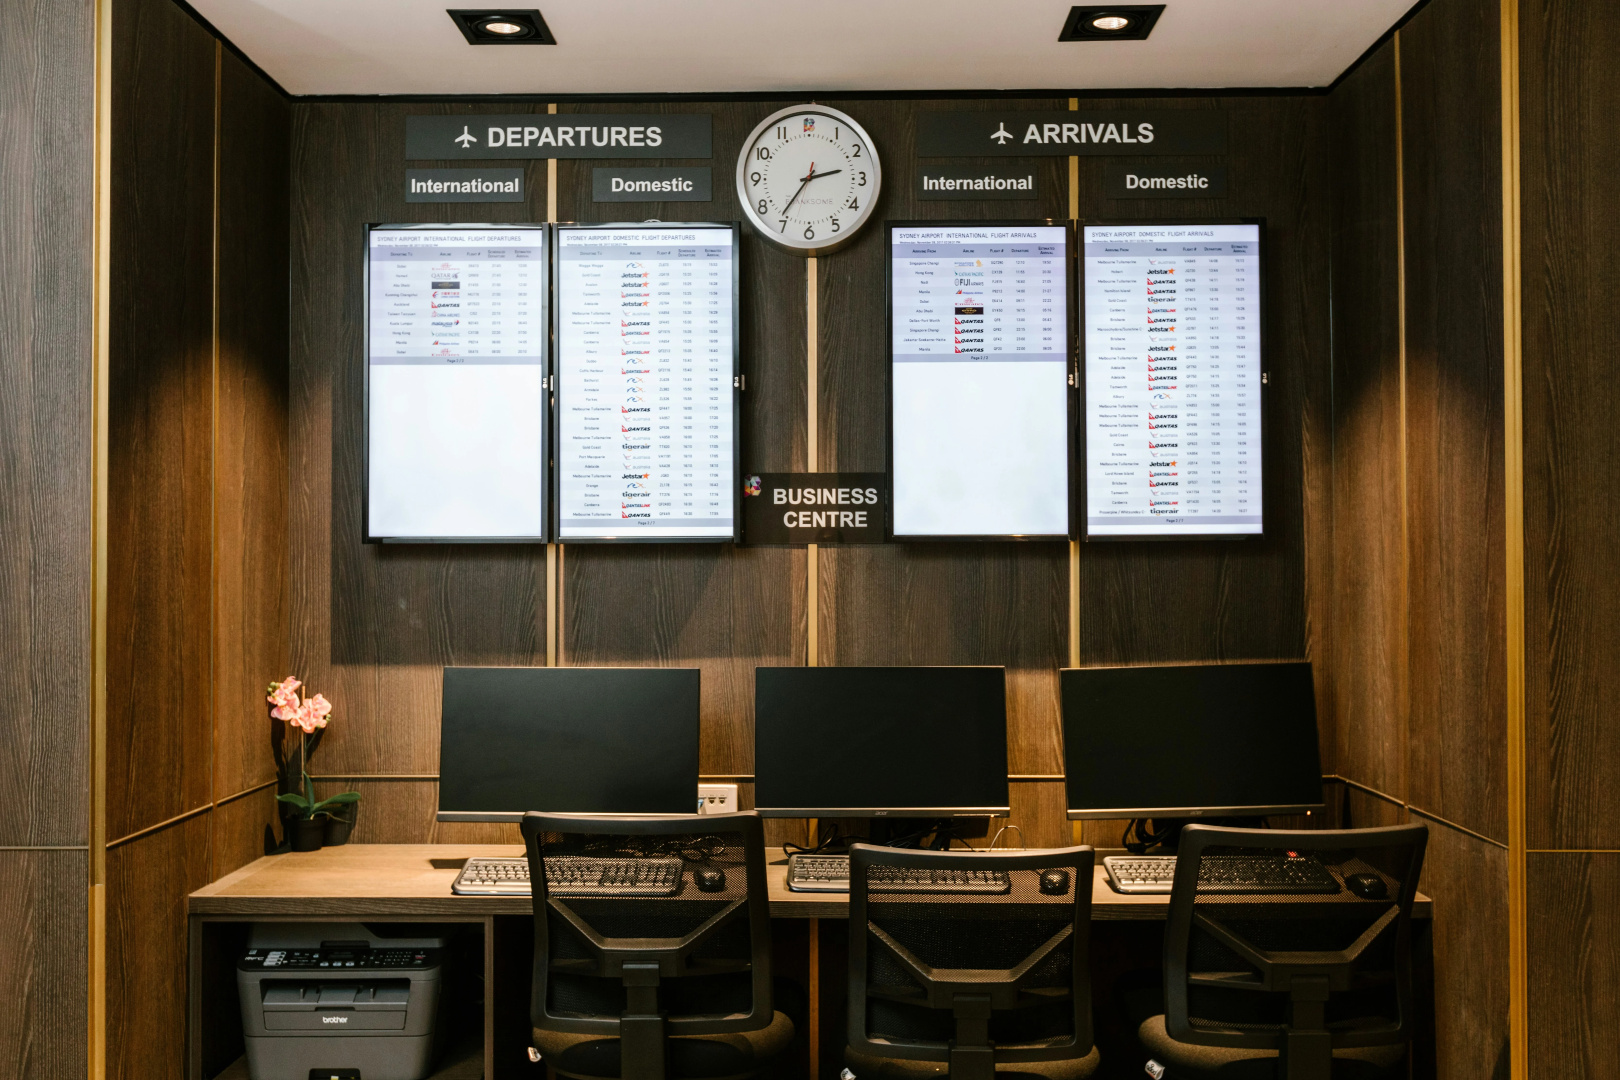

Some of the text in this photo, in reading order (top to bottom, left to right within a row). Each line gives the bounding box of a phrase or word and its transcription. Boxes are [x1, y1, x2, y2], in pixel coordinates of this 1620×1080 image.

[488, 126, 663, 148] DEPARTURES
[777, 127, 786, 139] 11
[835, 127, 838, 140] 1
[1023, 123, 1154, 143] ARRIVALS
[756, 147, 770, 160] 10
[852, 144, 861, 158] 2
[411, 178, 519, 193] International
[612, 178, 693, 192] Domestic
[751, 172, 761, 186] 9
[858, 172, 867, 186] 3
[923, 176, 1033, 190] International
[1126, 174, 1208, 189] Domestic
[758, 199, 768, 215] 8
[848, 196, 859, 211] 4
[778, 220, 787, 233] 7
[832, 219, 840, 232] 5
[804, 226, 814, 240] 6
[1148, 296, 1176, 304] tigerair
[622, 443, 651, 451] tigerair
[622, 491, 651, 499] tigerair
[774, 488, 878, 505] BUSINESS
[1150, 508, 1179, 516] tigerair
[783, 511, 868, 528] CENTRE
